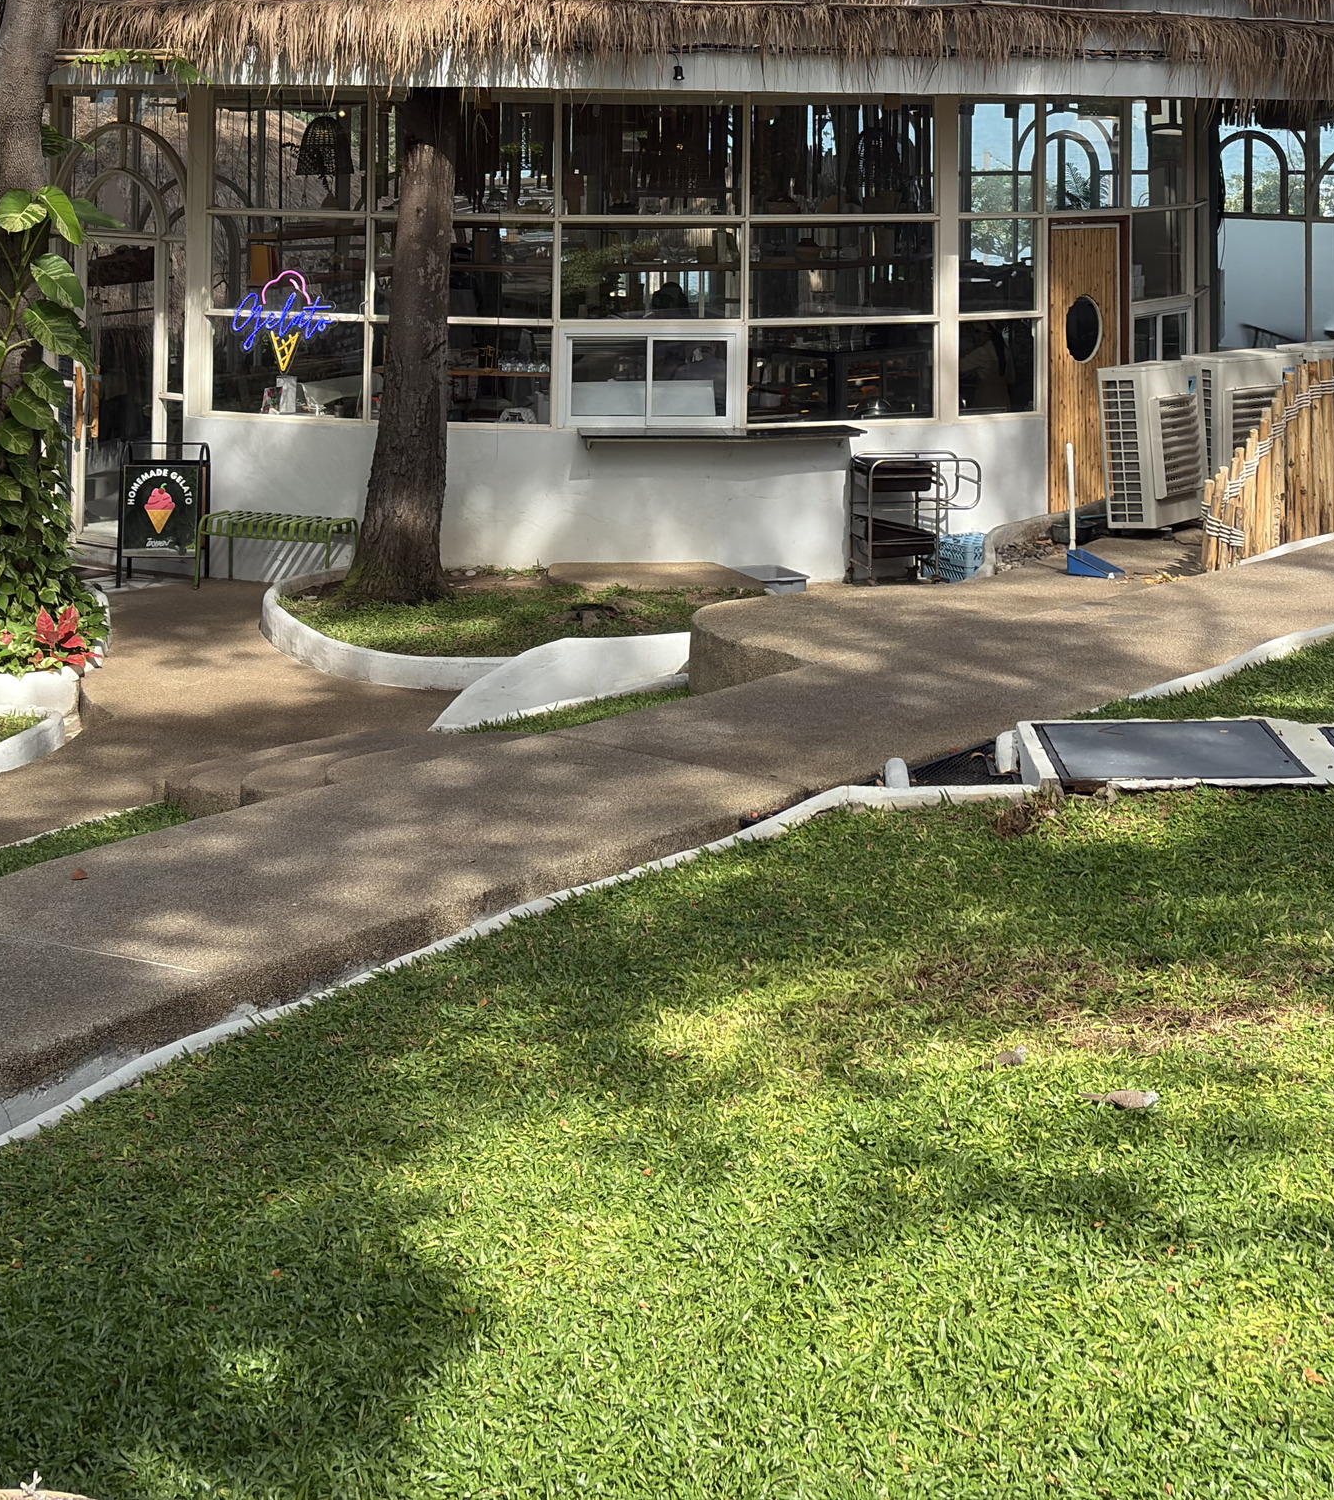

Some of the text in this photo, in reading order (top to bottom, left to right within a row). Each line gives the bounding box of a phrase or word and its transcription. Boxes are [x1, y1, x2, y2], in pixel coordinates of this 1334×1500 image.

[232, 292, 335, 351] Gelato
[127, 468, 192, 505] HOMEMADE GELATO
